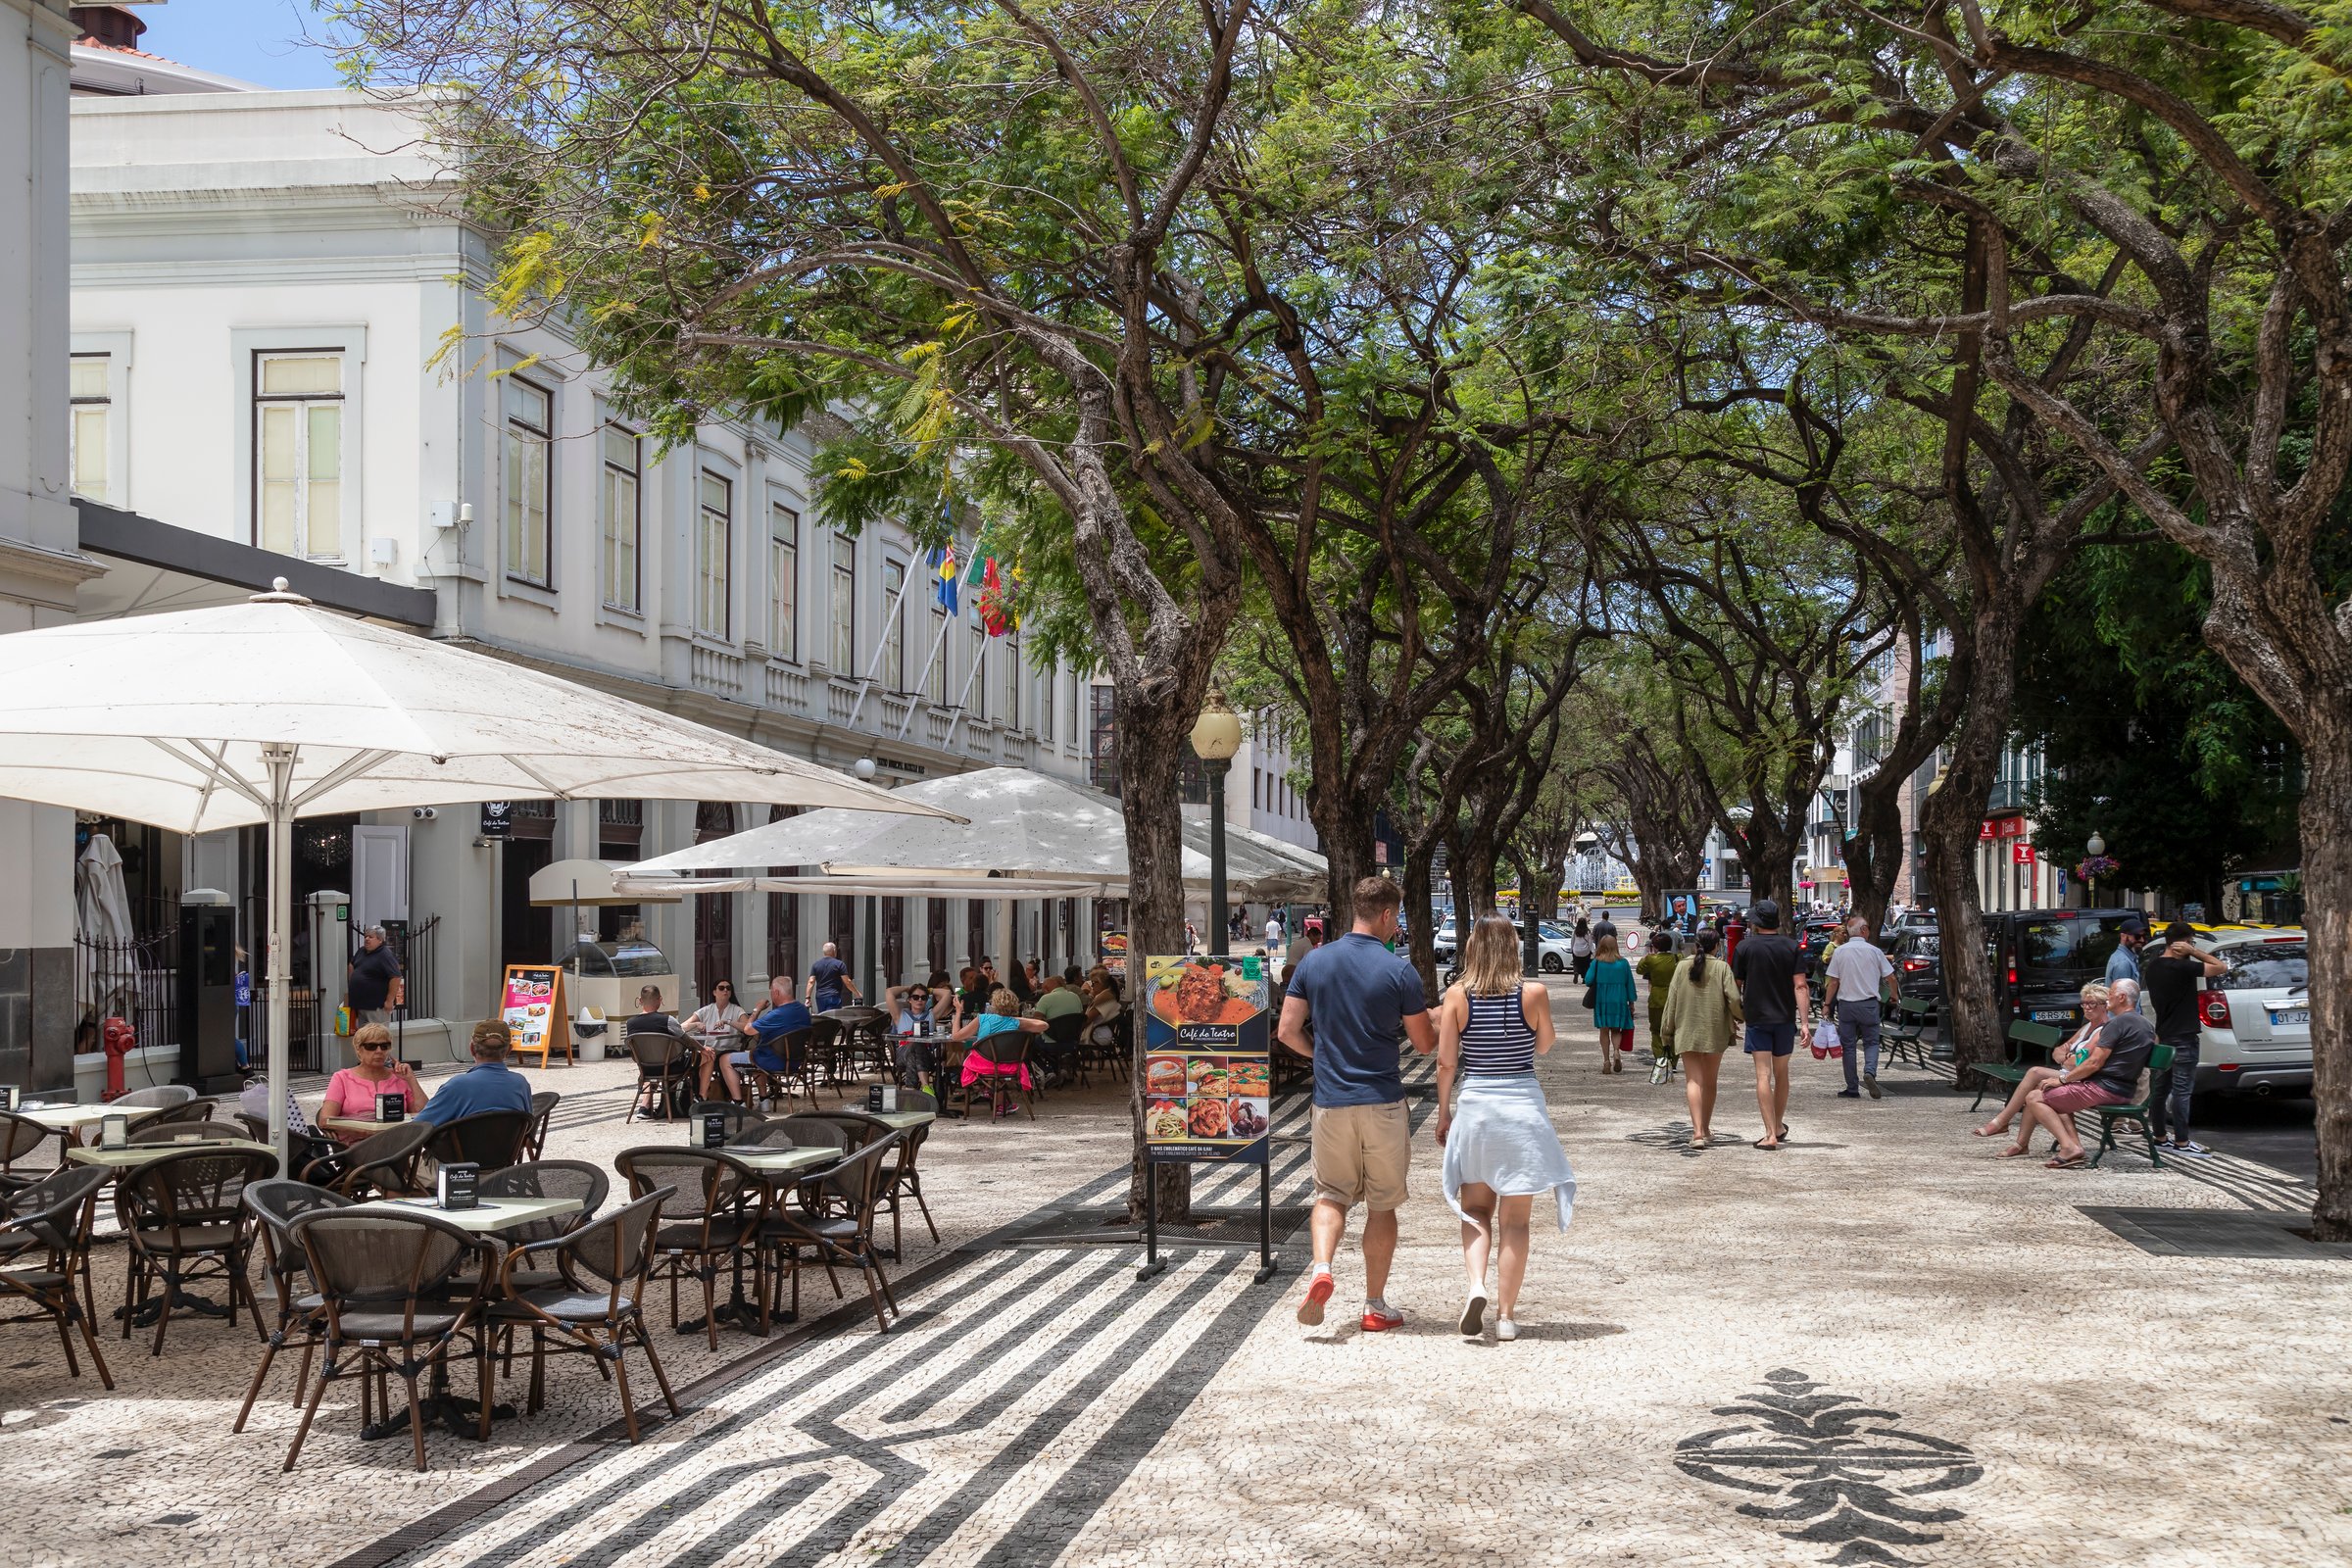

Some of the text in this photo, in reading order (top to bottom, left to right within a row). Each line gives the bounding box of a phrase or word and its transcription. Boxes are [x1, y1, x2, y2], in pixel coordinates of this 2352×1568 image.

[2036, 1011, 2071, 1020] 56-RS-24
[1180, 1027, 1236, 1041] Café do Teatro
